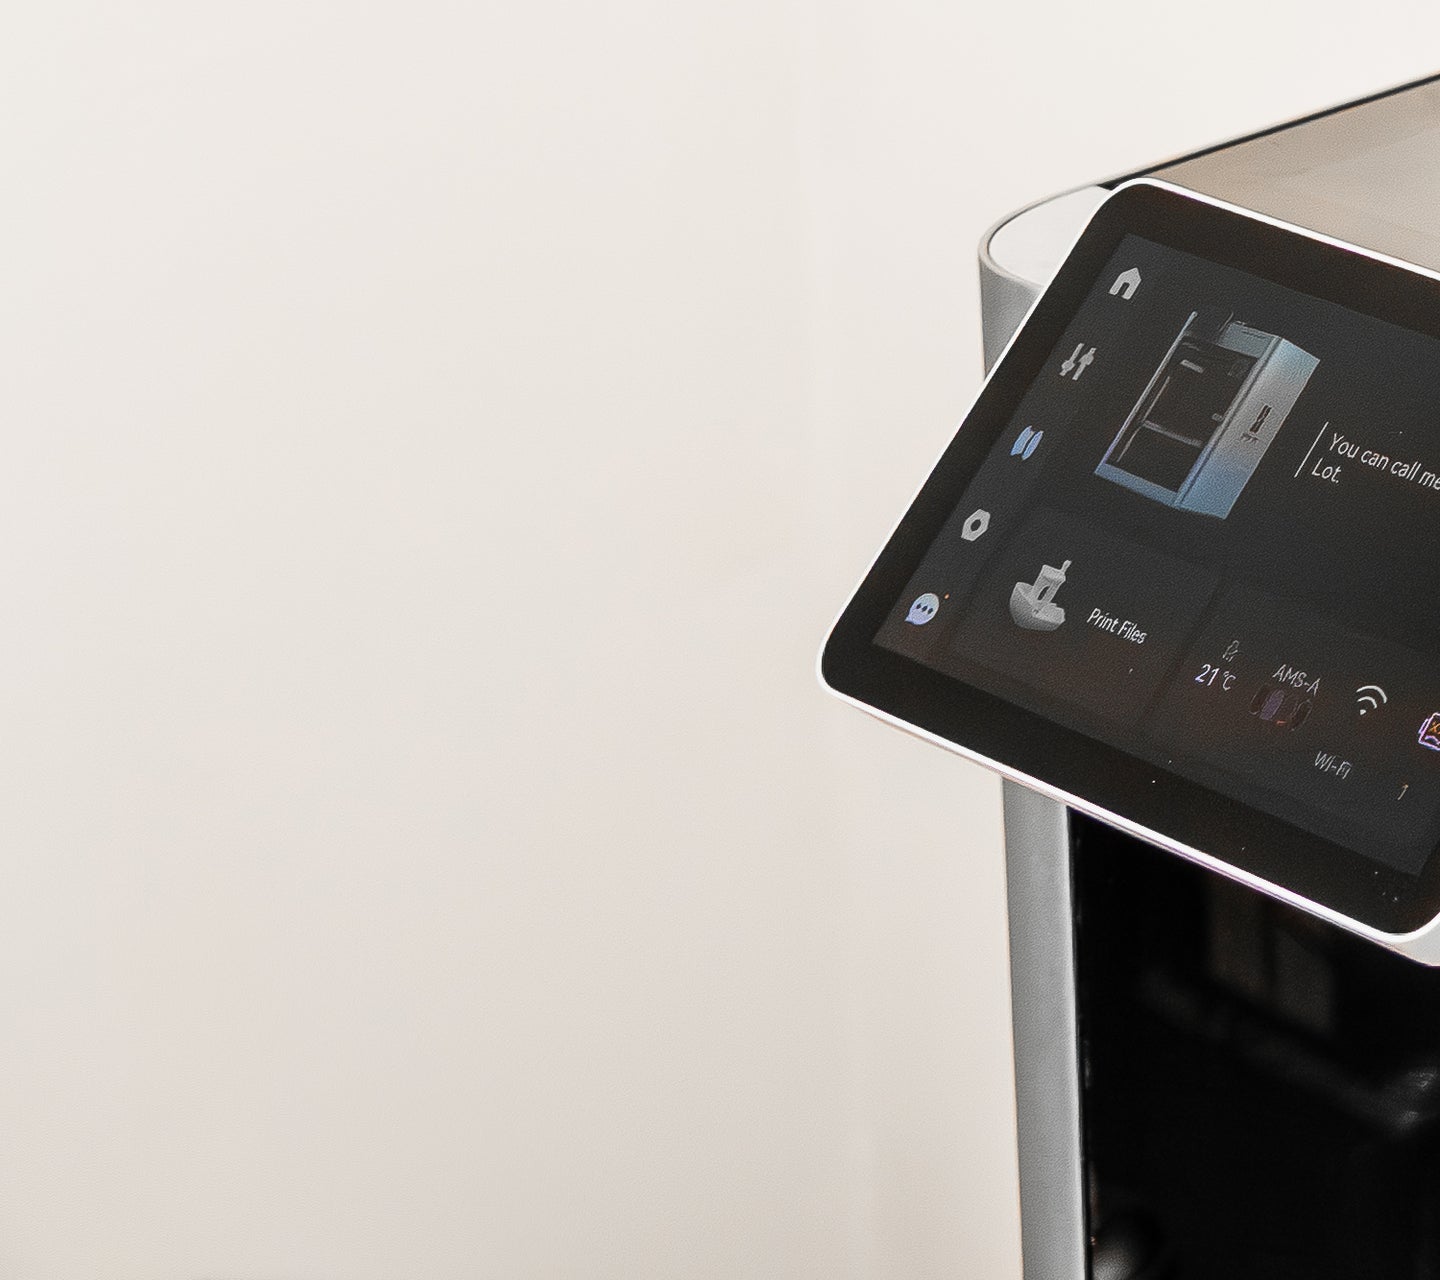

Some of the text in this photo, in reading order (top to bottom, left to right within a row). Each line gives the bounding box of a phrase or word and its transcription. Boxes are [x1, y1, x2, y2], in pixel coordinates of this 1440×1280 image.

[1312, 458, 1342, 483] Lot.
[1328, 433, 1360, 458] You
[1360, 449, 1390, 471] can
[1390, 460, 1422, 481] call
[1086, 607, 1147, 644] Print Files
[1272, 664, 1321, 696] AMS-A
